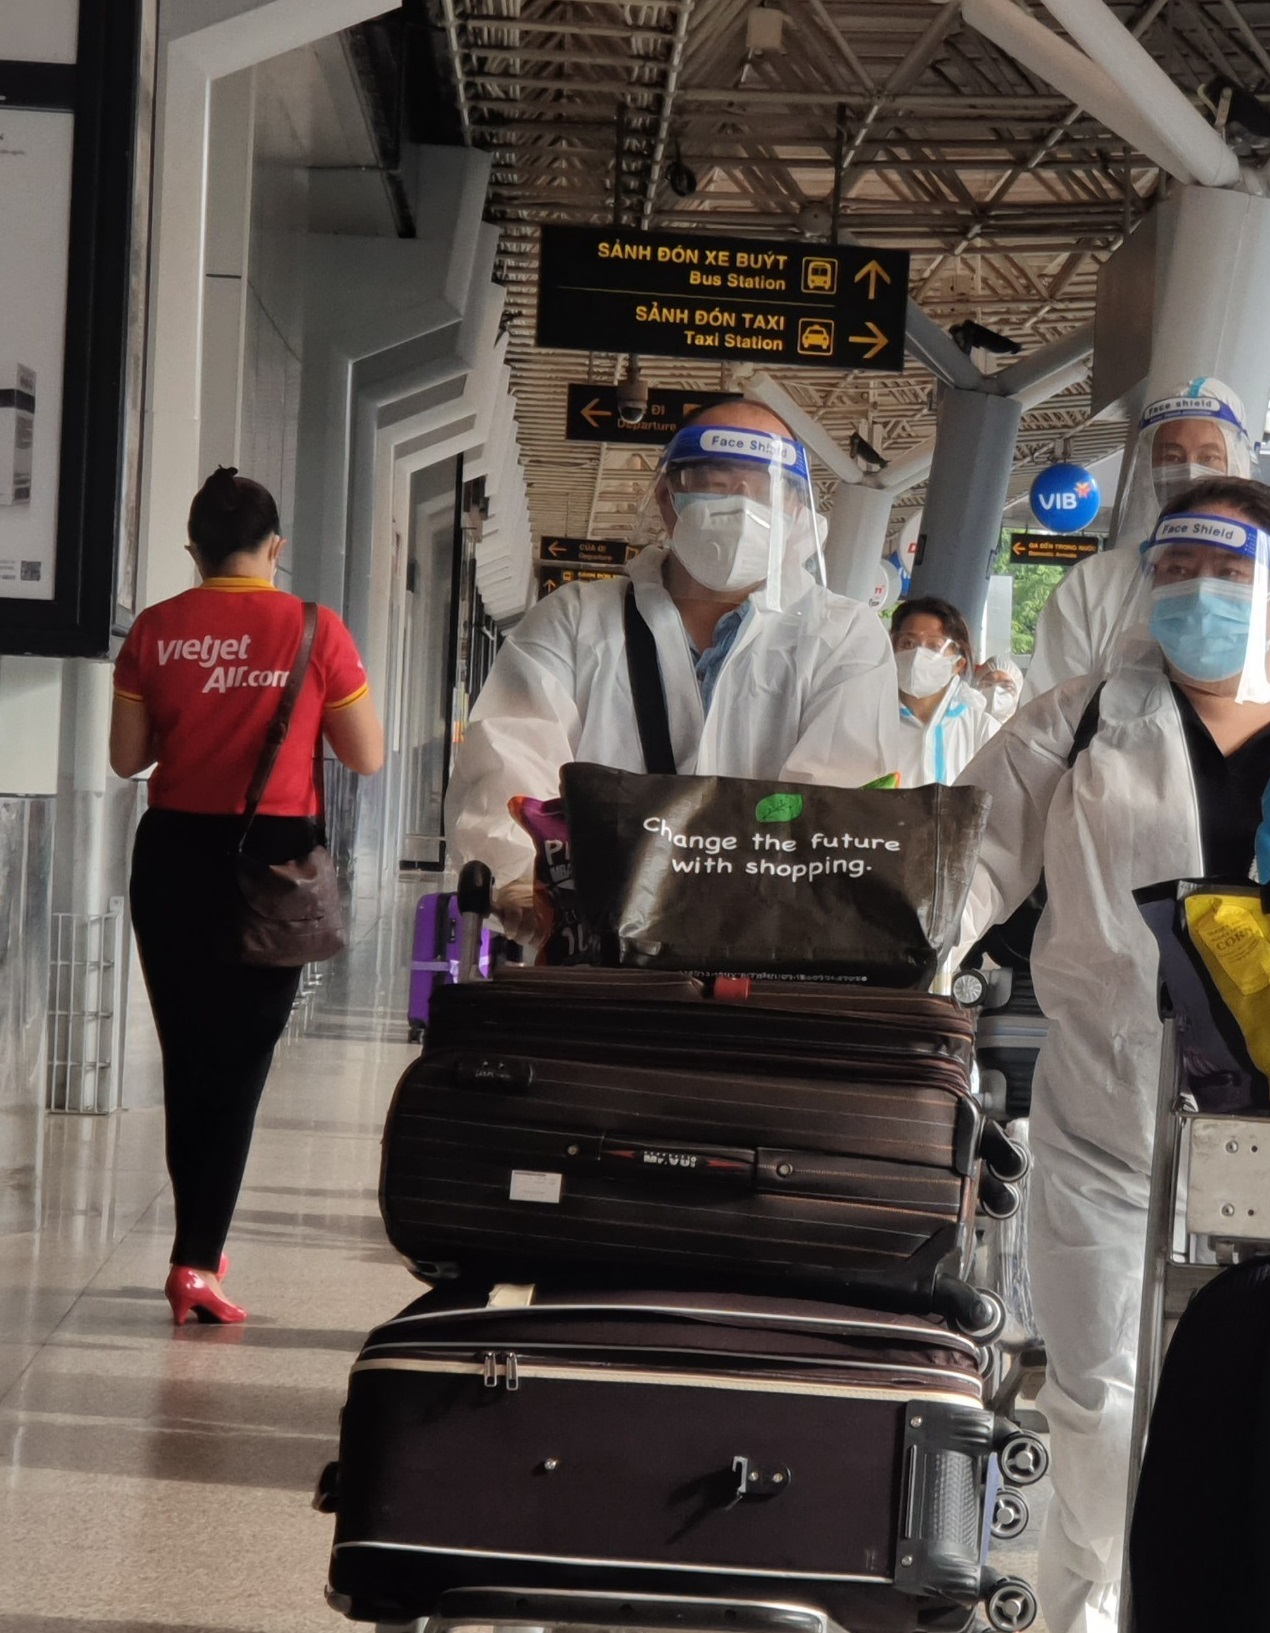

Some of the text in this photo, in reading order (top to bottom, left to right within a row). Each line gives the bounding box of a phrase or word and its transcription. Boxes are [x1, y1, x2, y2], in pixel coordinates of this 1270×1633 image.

[597, 239, 788, 270] SẢNH ĐÓN XE BUÝT
[690, 271, 786, 291] Bus Station
[635, 301, 785, 330] SẢNH ĐÓN TAXI
[684, 330, 783, 351] Taxi Station
[711, 435, 744, 449] Face
[1038, 492, 1078, 510] VIB
[1162, 523, 1235, 540] Face Shield
[643, 817, 901, 855] Change the future
[672, 857, 872, 883] with shopping.
